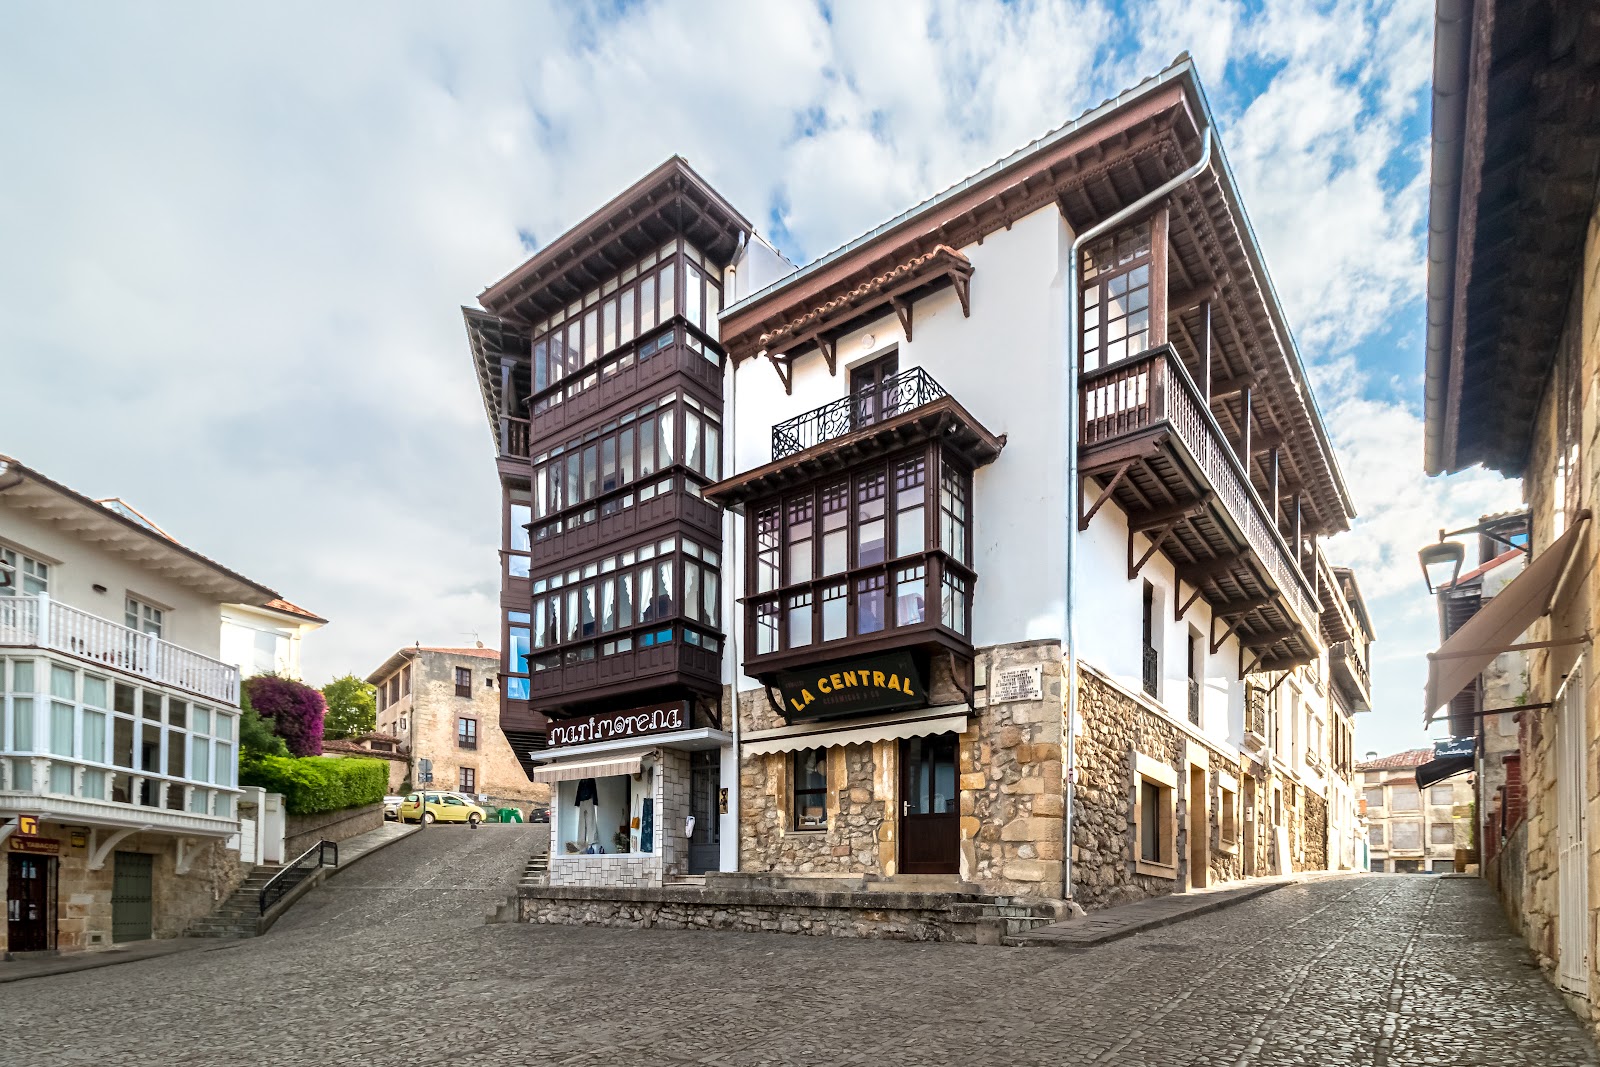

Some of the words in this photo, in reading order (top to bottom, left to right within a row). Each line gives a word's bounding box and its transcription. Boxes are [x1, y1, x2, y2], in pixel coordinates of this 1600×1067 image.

[791, 689, 815, 711] LA
[818, 670, 914, 696] CENTRAL
[26, 841, 59, 850] TABACOS
